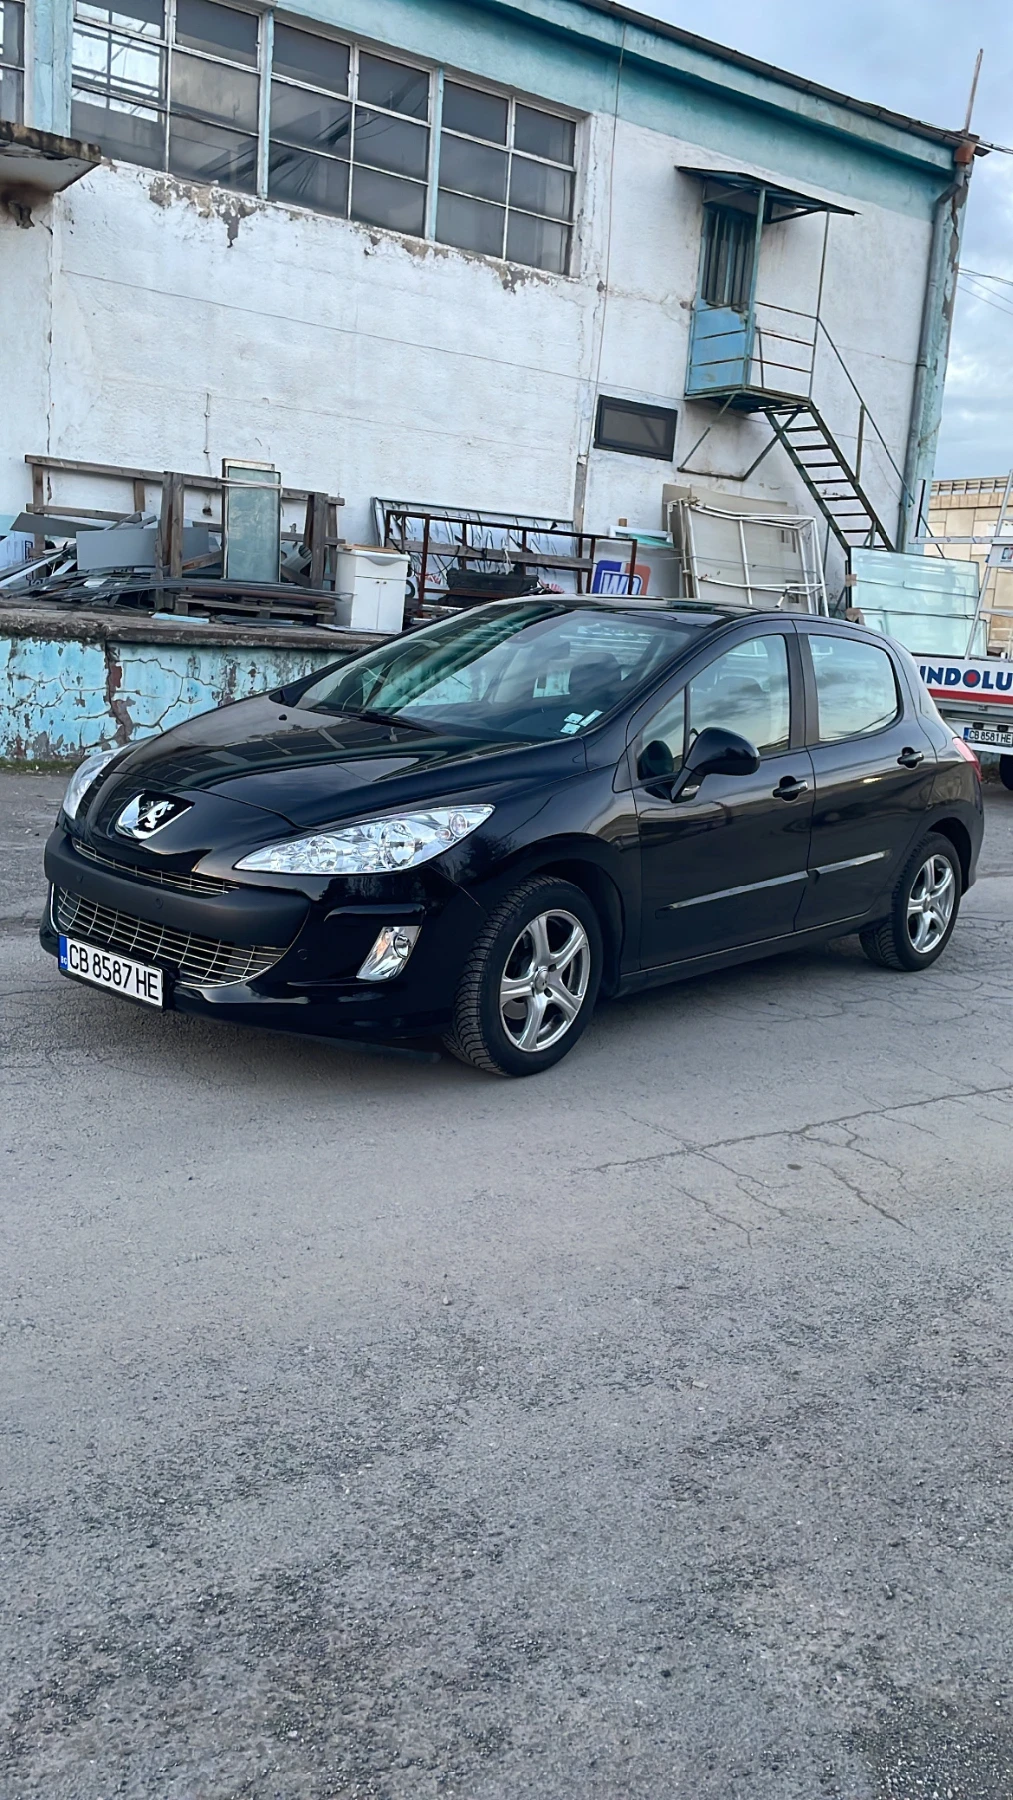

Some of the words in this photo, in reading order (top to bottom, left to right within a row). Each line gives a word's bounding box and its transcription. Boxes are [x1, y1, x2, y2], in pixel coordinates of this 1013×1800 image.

[969, 731, 980, 739] CB
[69, 944, 89, 973] CB
[93, 953, 132, 988] 8587
[136, 967, 159, 1000] HE
